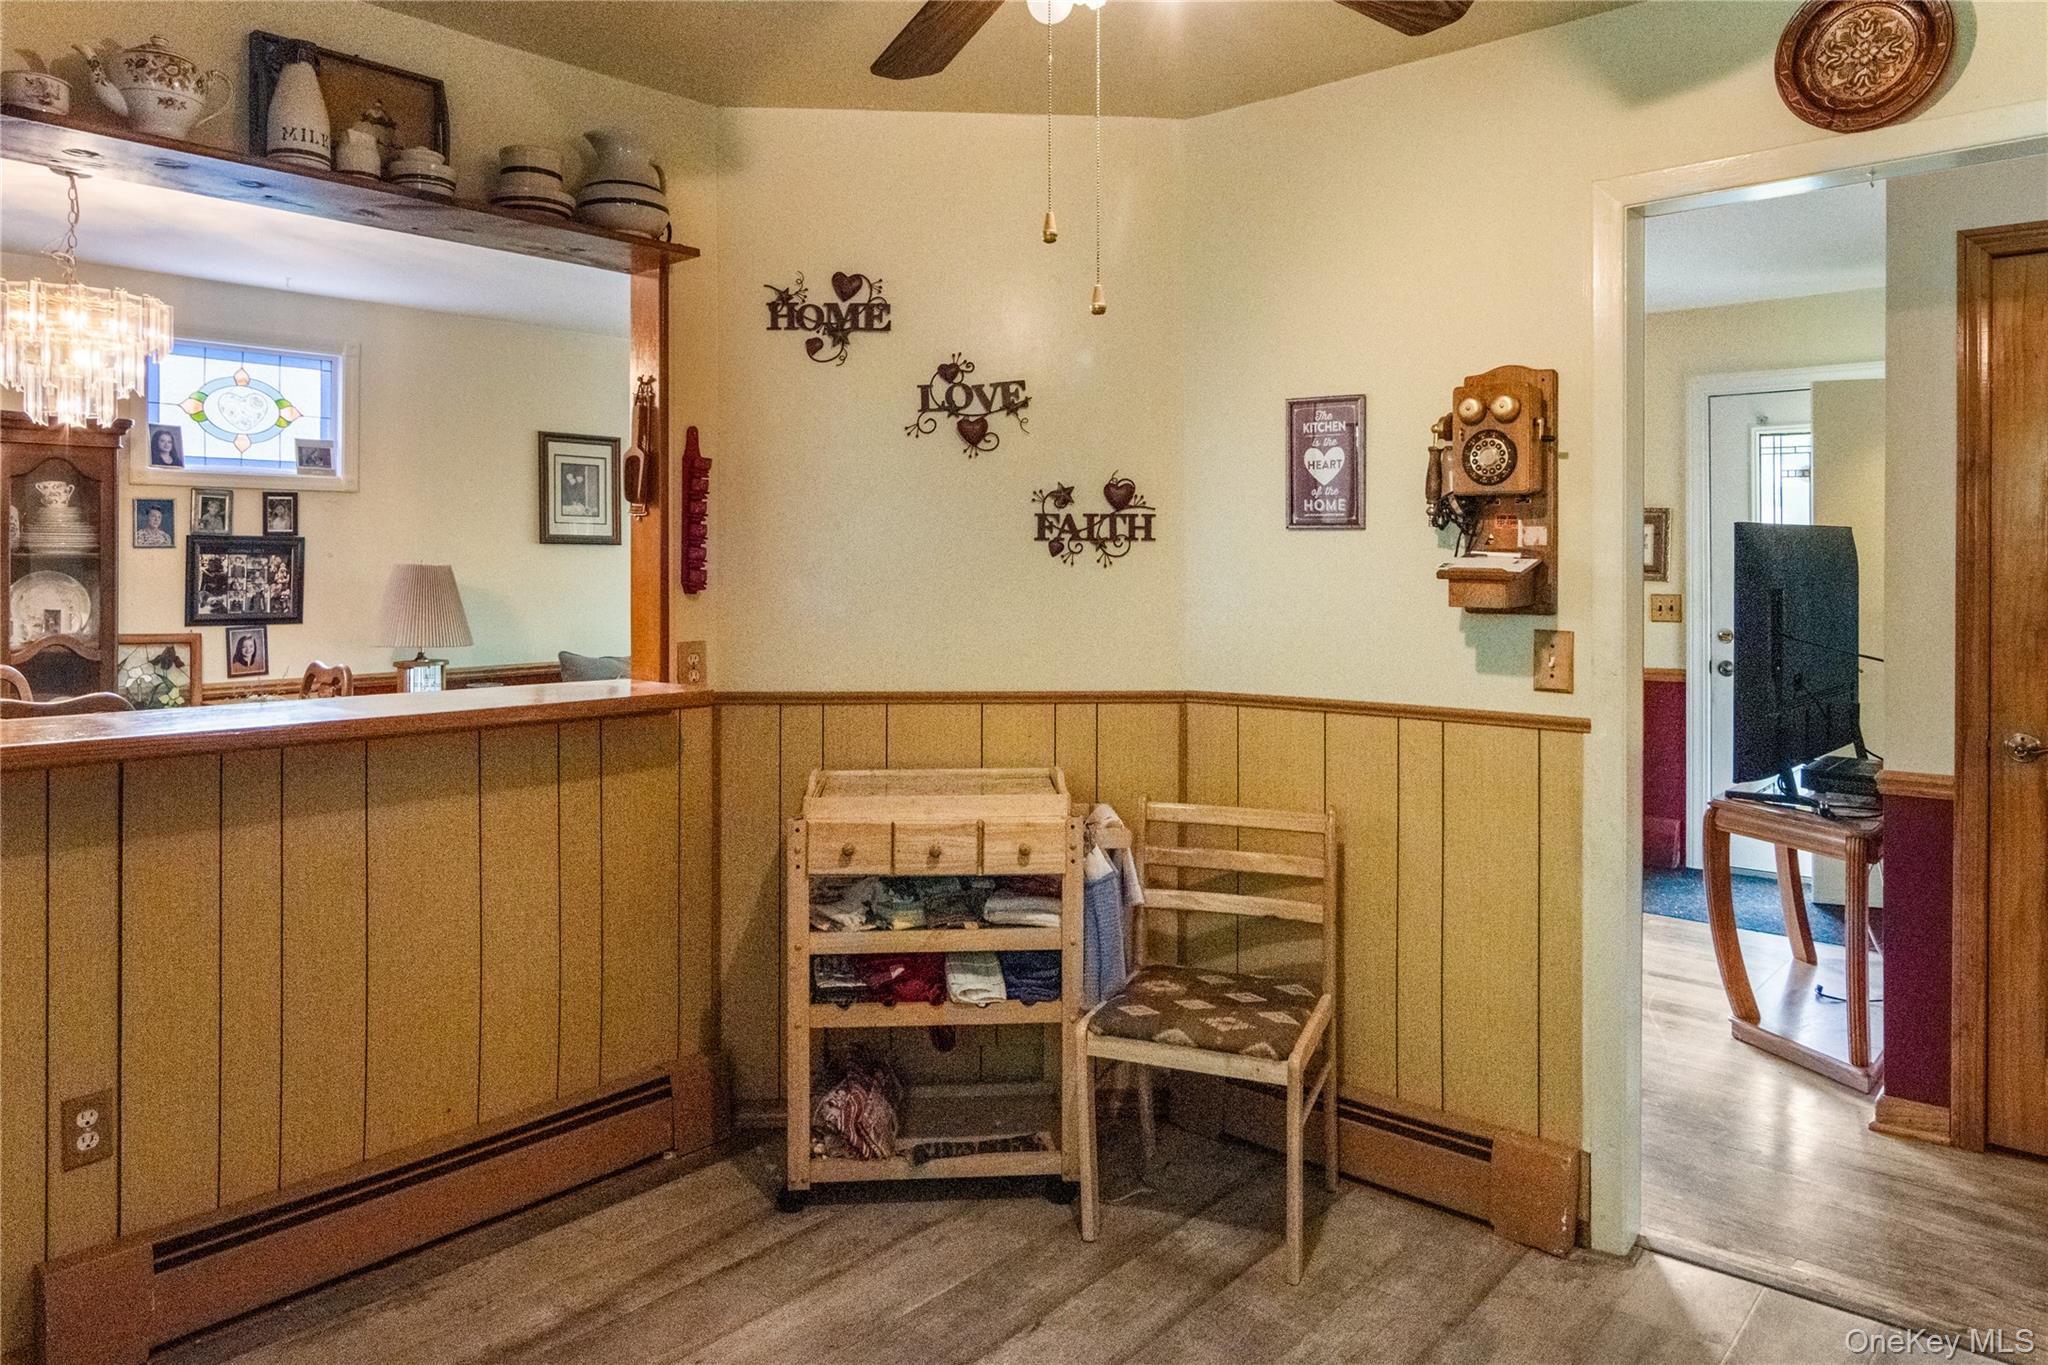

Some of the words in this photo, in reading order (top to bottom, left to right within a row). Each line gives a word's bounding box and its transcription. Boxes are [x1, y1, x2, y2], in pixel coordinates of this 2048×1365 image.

[282, 127, 329, 150] MILK
[766, 302, 891, 332] HOME
[917, 380, 1027, 413] LOVE
[1315, 410, 1333, 421] The
[1303, 421, 1346, 433] KITCHEN
[1312, 438, 1320, 447] is
[1323, 437, 1338, 447] the
[1308, 460, 1342, 470] HEART
[1311, 486, 1322, 499] of
[1325, 487, 1339, 496] the
[1304, 499, 1346, 512] HOME
[1034, 513, 1156, 542] FAITH
